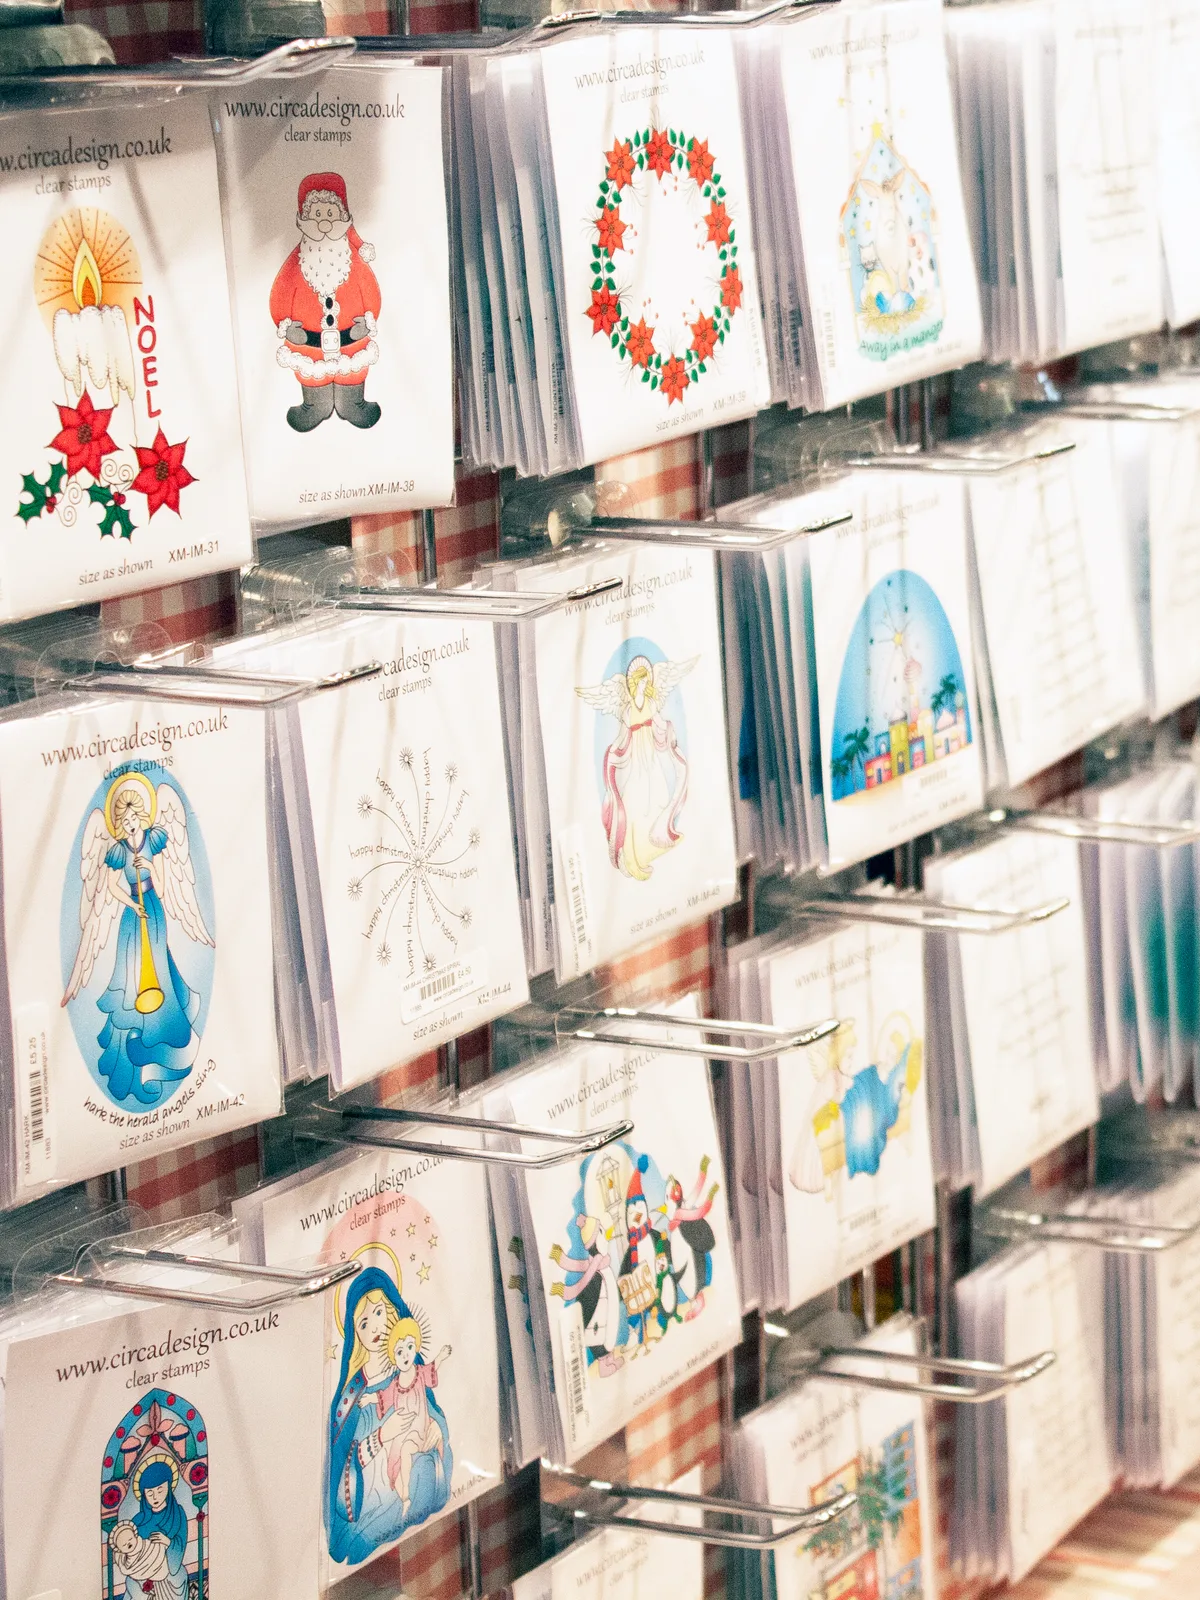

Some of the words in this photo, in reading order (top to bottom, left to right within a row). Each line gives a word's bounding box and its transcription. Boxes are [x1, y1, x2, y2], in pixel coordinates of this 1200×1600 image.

[225, 92, 405, 127] www.circadesign.co.uk
[284, 124, 311, 142] clear
[313, 127, 352, 147] stamps
[35, 175, 65, 195] clear
[67, 175, 112, 194] stamps
[133, 295, 162, 418] NOEL
[299, 489, 318, 503] size
[320, 490, 332, 501] as
[334, 484, 366, 500] shown
[367, 480, 415, 496] XM-IM-38
[79, 570, 100, 585] size
[103, 568, 115, 580] as
[118, 558, 153, 576] shown
[168, 540, 219, 563] XM-IM-31
[378, 684, 400, 701] clear
[402, 676, 432, 695] stamps
[41, 707, 229, 767] www.circadesign.co.uk
[103, 761, 131, 781] clear
[133, 755, 174, 773] stamps
[413, 1026, 428, 1040] size
[429, 1022, 438, 1033] as
[439, 1011, 464, 1028] shown
[109, 1112, 124, 1127] the
[127, 1112, 159, 1128] herald
[162, 1088, 195, 1119] angels
[119, 1134, 139, 1150] size
[142, 1130, 154, 1143] as
[156, 1118, 190, 1139] shown
[196, 1093, 245, 1121] XM-IM-42
[350, 1210, 372, 1231] clear
[373, 1195, 406, 1219] stamps
[56, 1312, 279, 1382] www.circadesign.co.uk
[125, 1370, 159, 1389] clear
[161, 1358, 210, 1381] stamps
